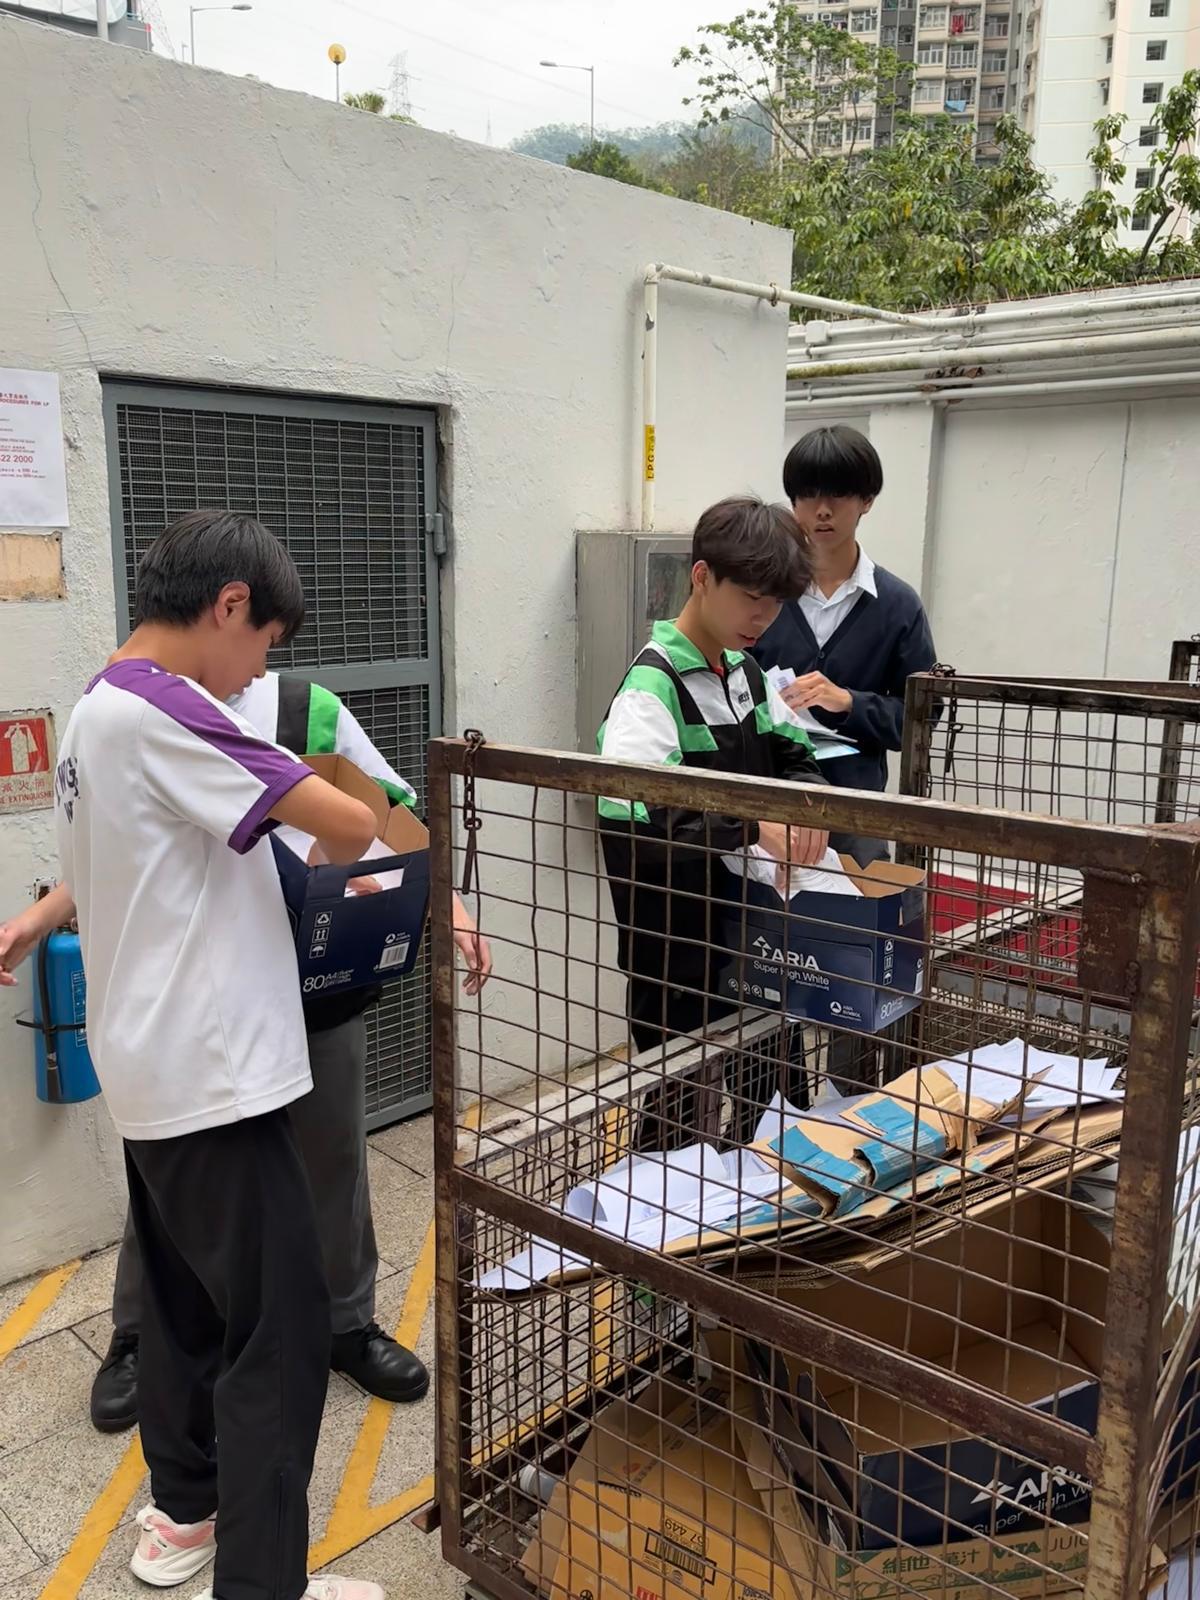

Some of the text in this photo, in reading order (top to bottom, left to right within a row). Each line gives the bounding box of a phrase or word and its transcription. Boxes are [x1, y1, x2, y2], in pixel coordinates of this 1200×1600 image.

[0, 454, 34, 464] 22 2000
[9, 791, 54, 803] EXTINGUISHE
[772, 948, 820, 972] ARIA
[754, 960, 779, 974] Super
[802, 971, 830, 986] White
[302, 974, 325, 993] 80
[881, 1001, 893, 1020] 80
[664, 1518, 687, 1536] 449
[972, 1511, 1023, 1537] Super
[1049, 1535, 1089, 1552] JUIC
